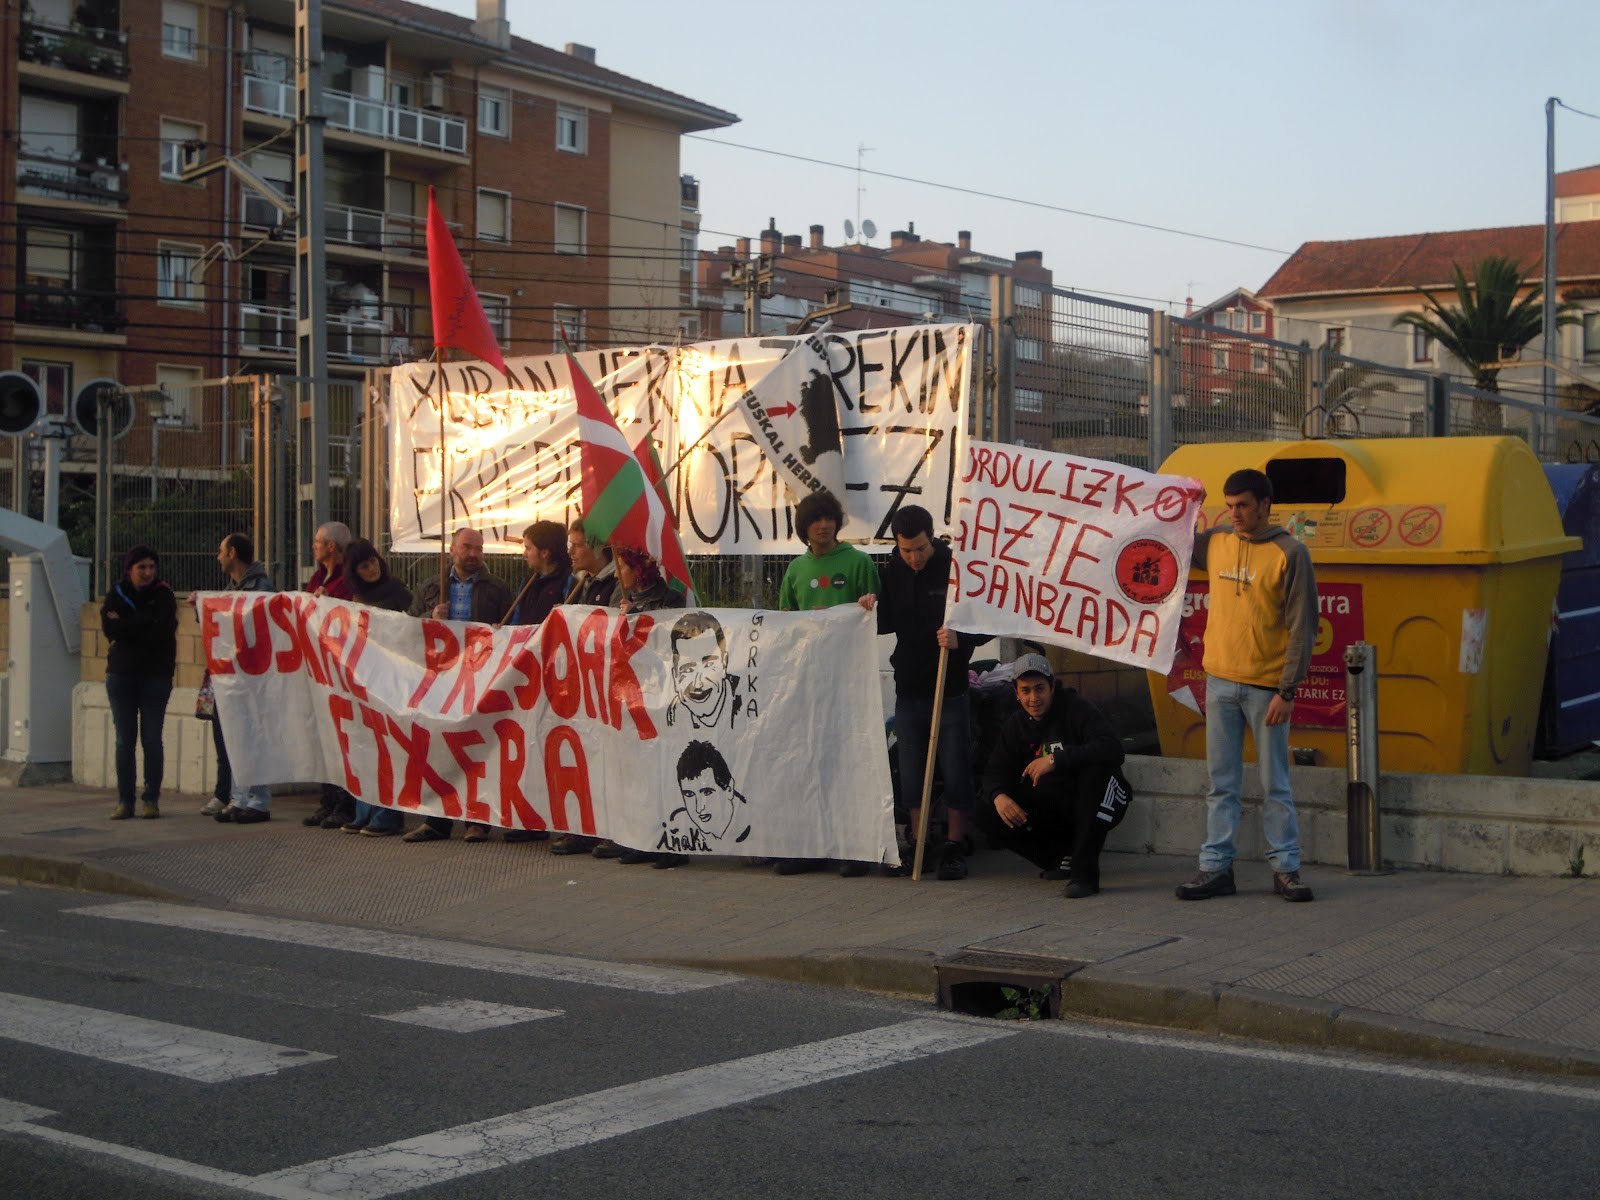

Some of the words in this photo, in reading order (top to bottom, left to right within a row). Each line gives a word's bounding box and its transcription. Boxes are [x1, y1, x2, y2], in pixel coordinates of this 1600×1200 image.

[759, 327, 966, 414] REKIN
[805, 335, 833, 371] EUS
[742, 390, 785, 454] EUSKAL
[782, 453, 831, 494] HERRI
[948, 557, 1160, 657] ASANBLADA
[1318, 594, 1350, 615] rra
[201, 592, 371, 699] EUSKAL
[407, 606, 659, 741] PRESOAK
[746, 611, 764, 717] GORKA
[1294, 688, 1329, 700] TARIK
[1332, 689, 1346, 700] EZ
[329, 695, 597, 836] ETXERA
